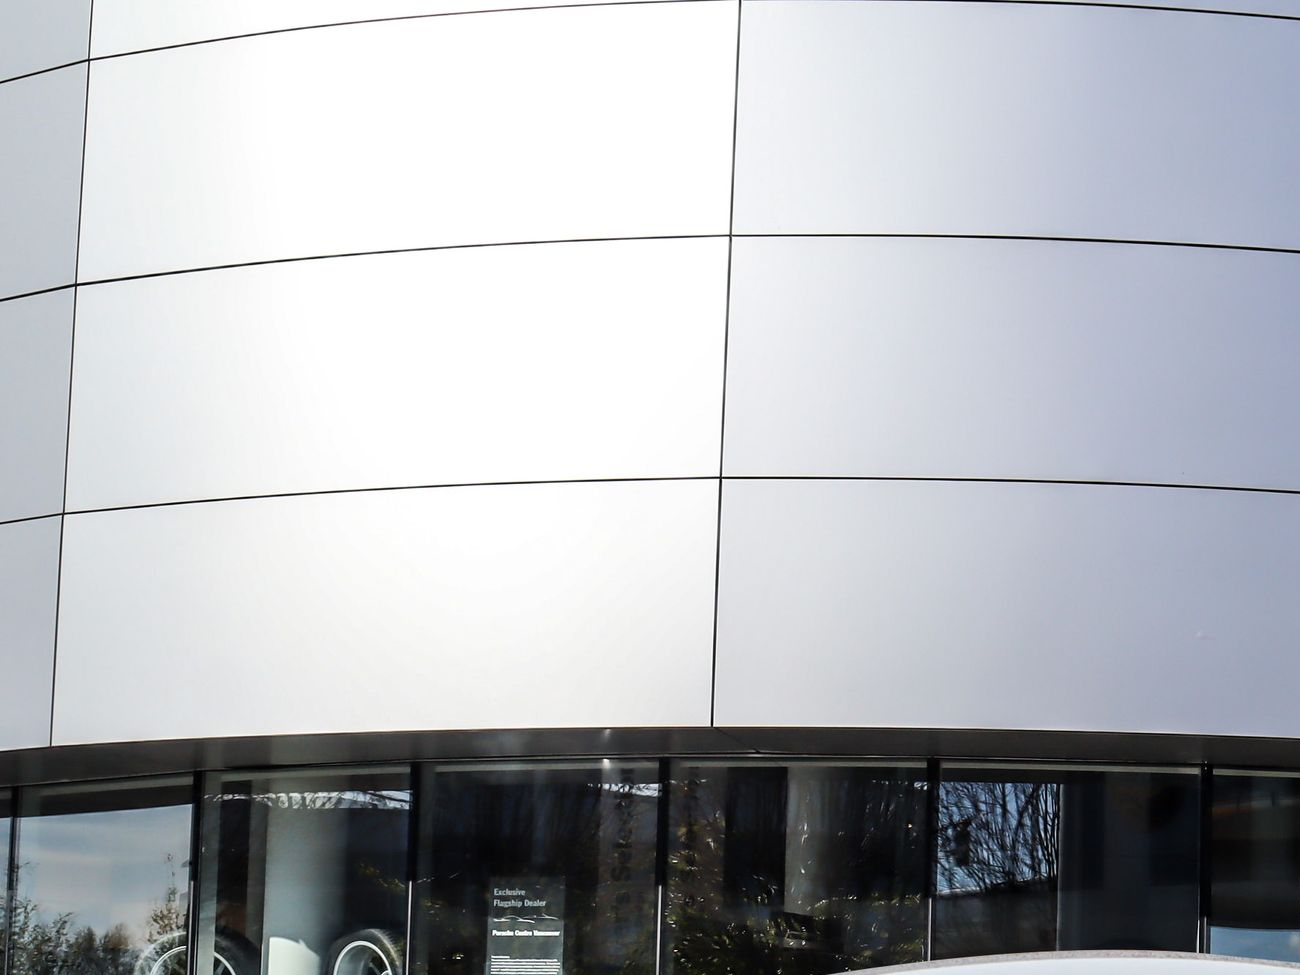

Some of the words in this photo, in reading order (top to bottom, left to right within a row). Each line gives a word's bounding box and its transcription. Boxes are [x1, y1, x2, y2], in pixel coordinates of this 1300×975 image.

[493, 888, 526, 896] Exclusive
[493, 899, 523, 908] Flagship
[524, 899, 547, 907] Dealer
